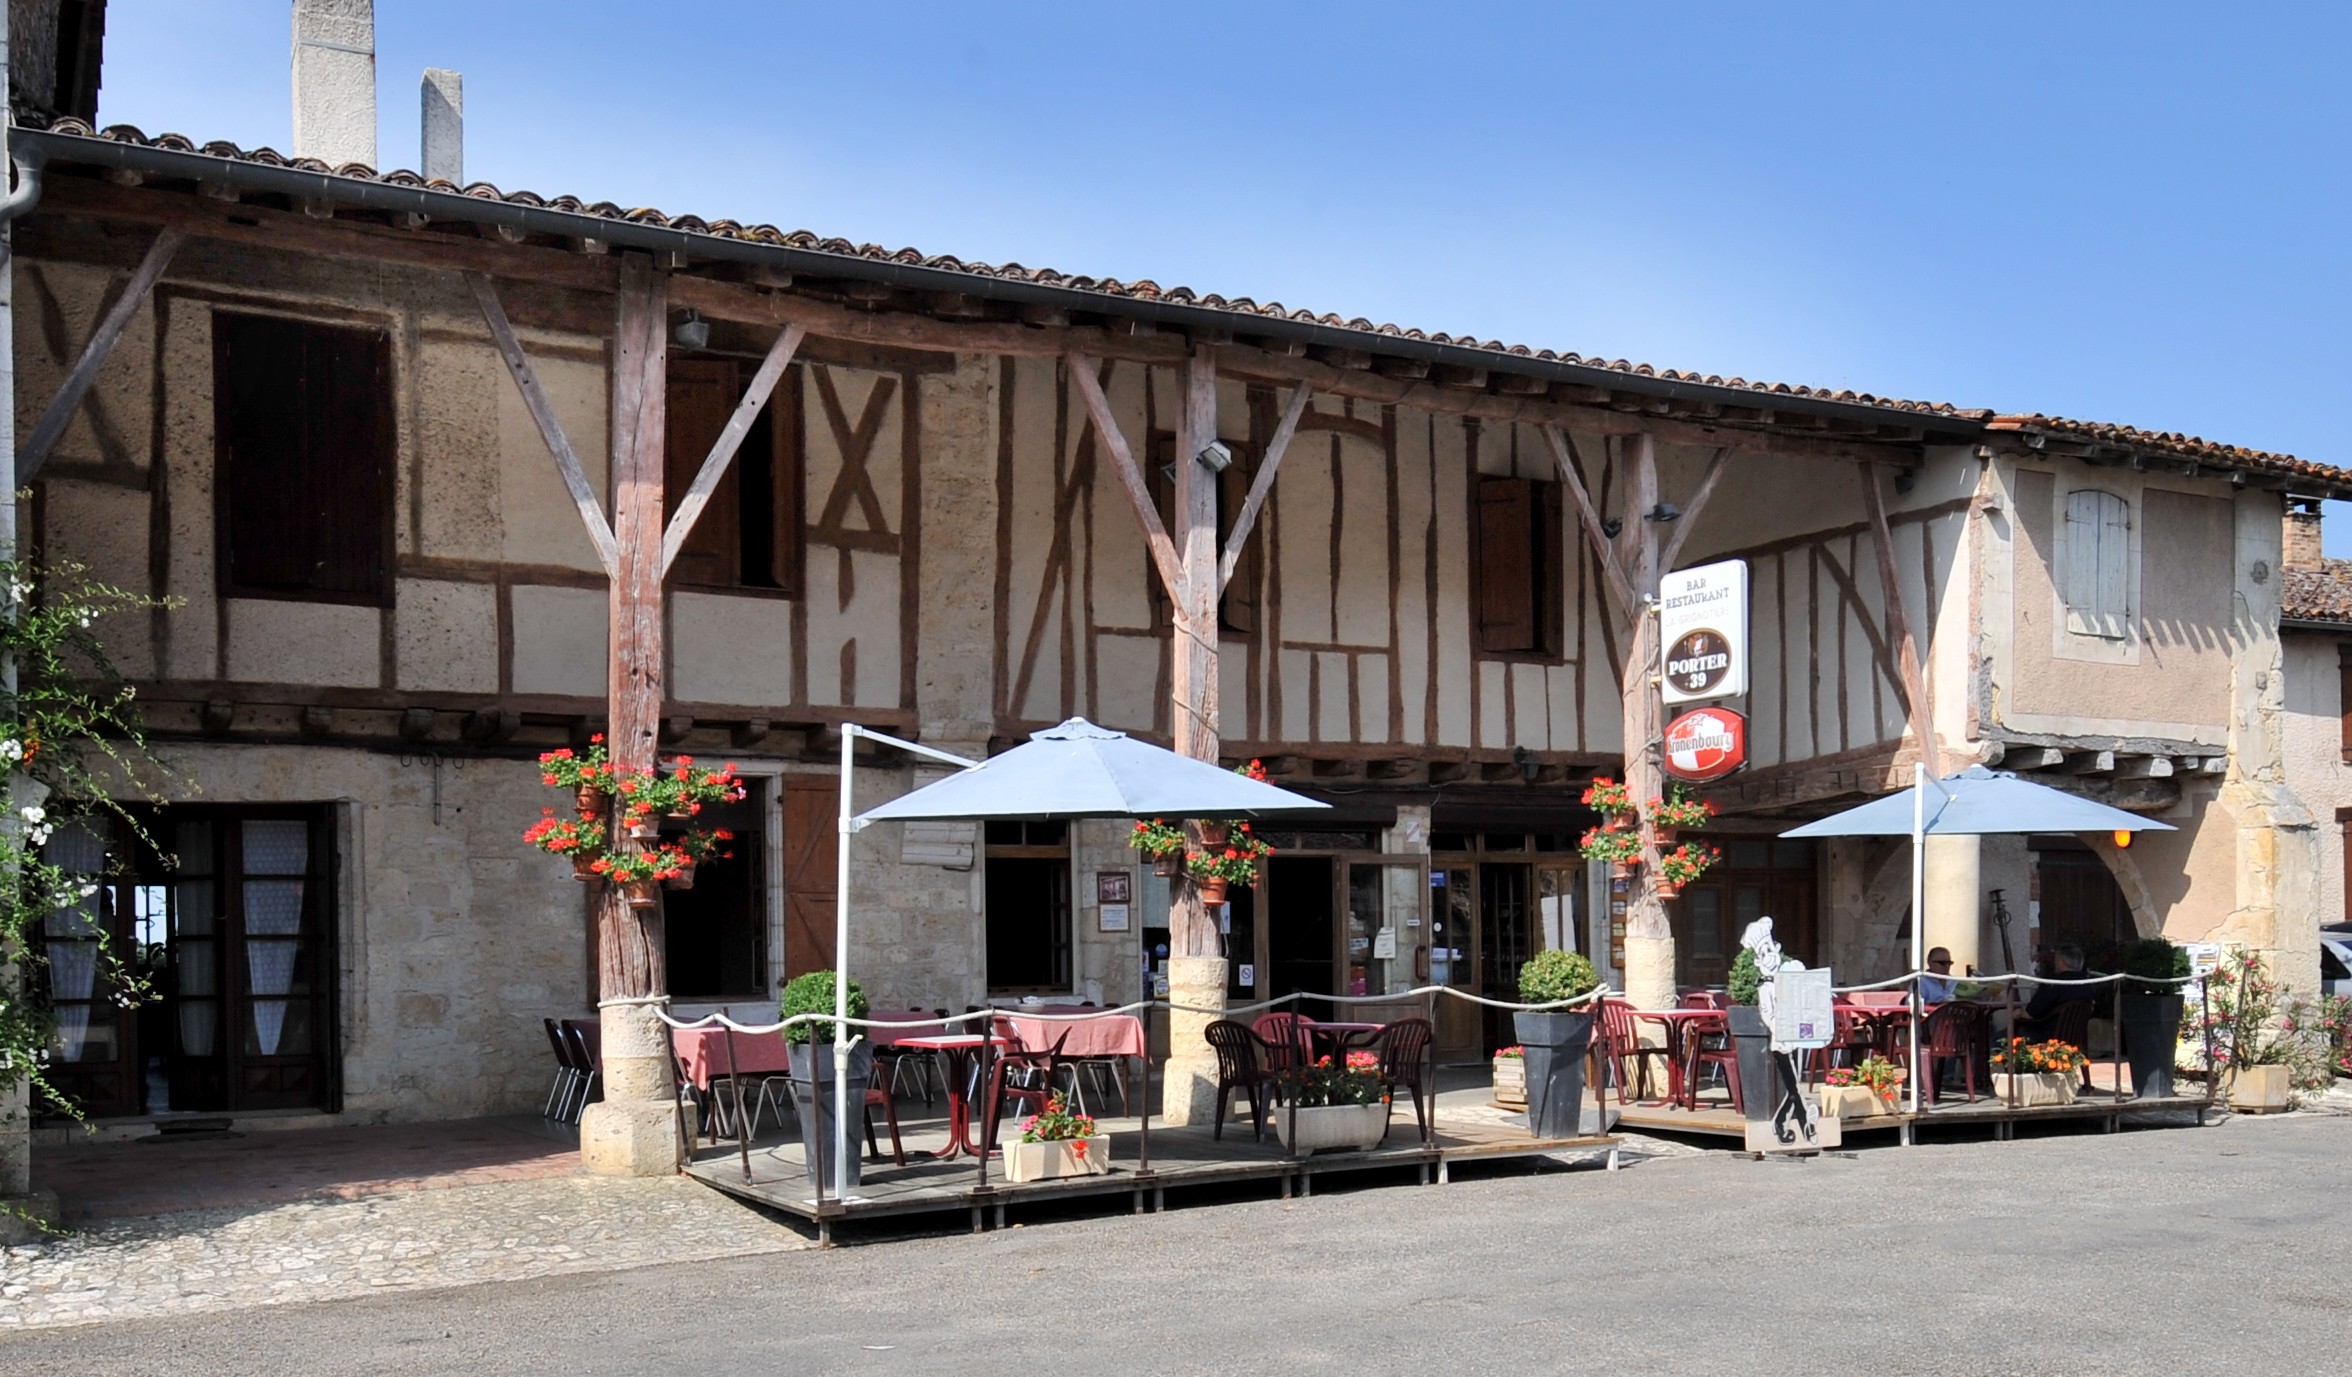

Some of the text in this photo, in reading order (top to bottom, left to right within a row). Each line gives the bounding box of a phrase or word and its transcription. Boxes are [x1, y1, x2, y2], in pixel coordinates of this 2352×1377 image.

[1686, 578, 1707, 591] BAR
[1665, 587, 1730, 610] RESTAURANT
[1665, 617, 1675, 627] LA
[1668, 652, 1727, 676] PORTER
[1689, 672, 1707, 689] 39
[1667, 732, 1733, 754] Kronenbourg
